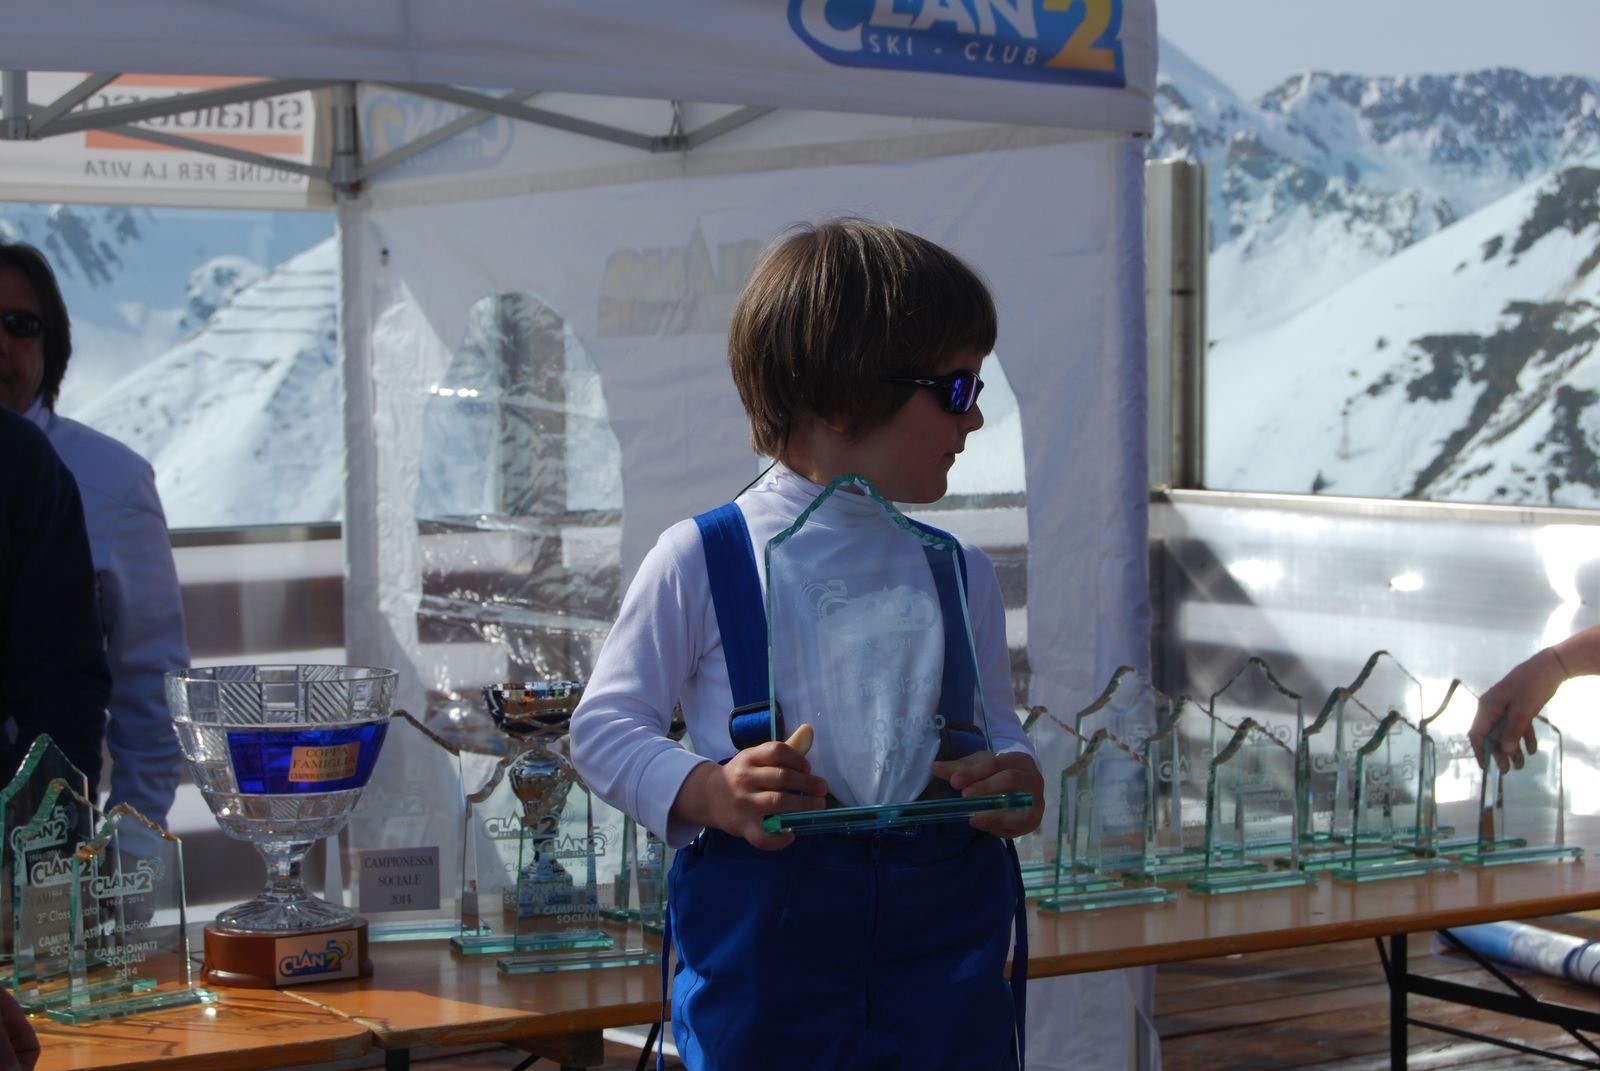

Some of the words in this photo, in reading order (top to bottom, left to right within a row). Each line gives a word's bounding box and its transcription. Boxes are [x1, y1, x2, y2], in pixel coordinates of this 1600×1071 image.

[869, 34, 913, 57] SKI
[964, 42, 1038, 65] CLUB
[364, 855, 434, 869] CAMPIONESSA
[91, 870, 151, 895] CLAN2
[377, 874, 422, 887] SOCIALE
[389, 894, 412, 905] 2014
[94, 940, 159, 958] CAMPIONATI
[106, 953, 147, 967] SOCIALI
[280, 950, 339, 975] CLAN2
